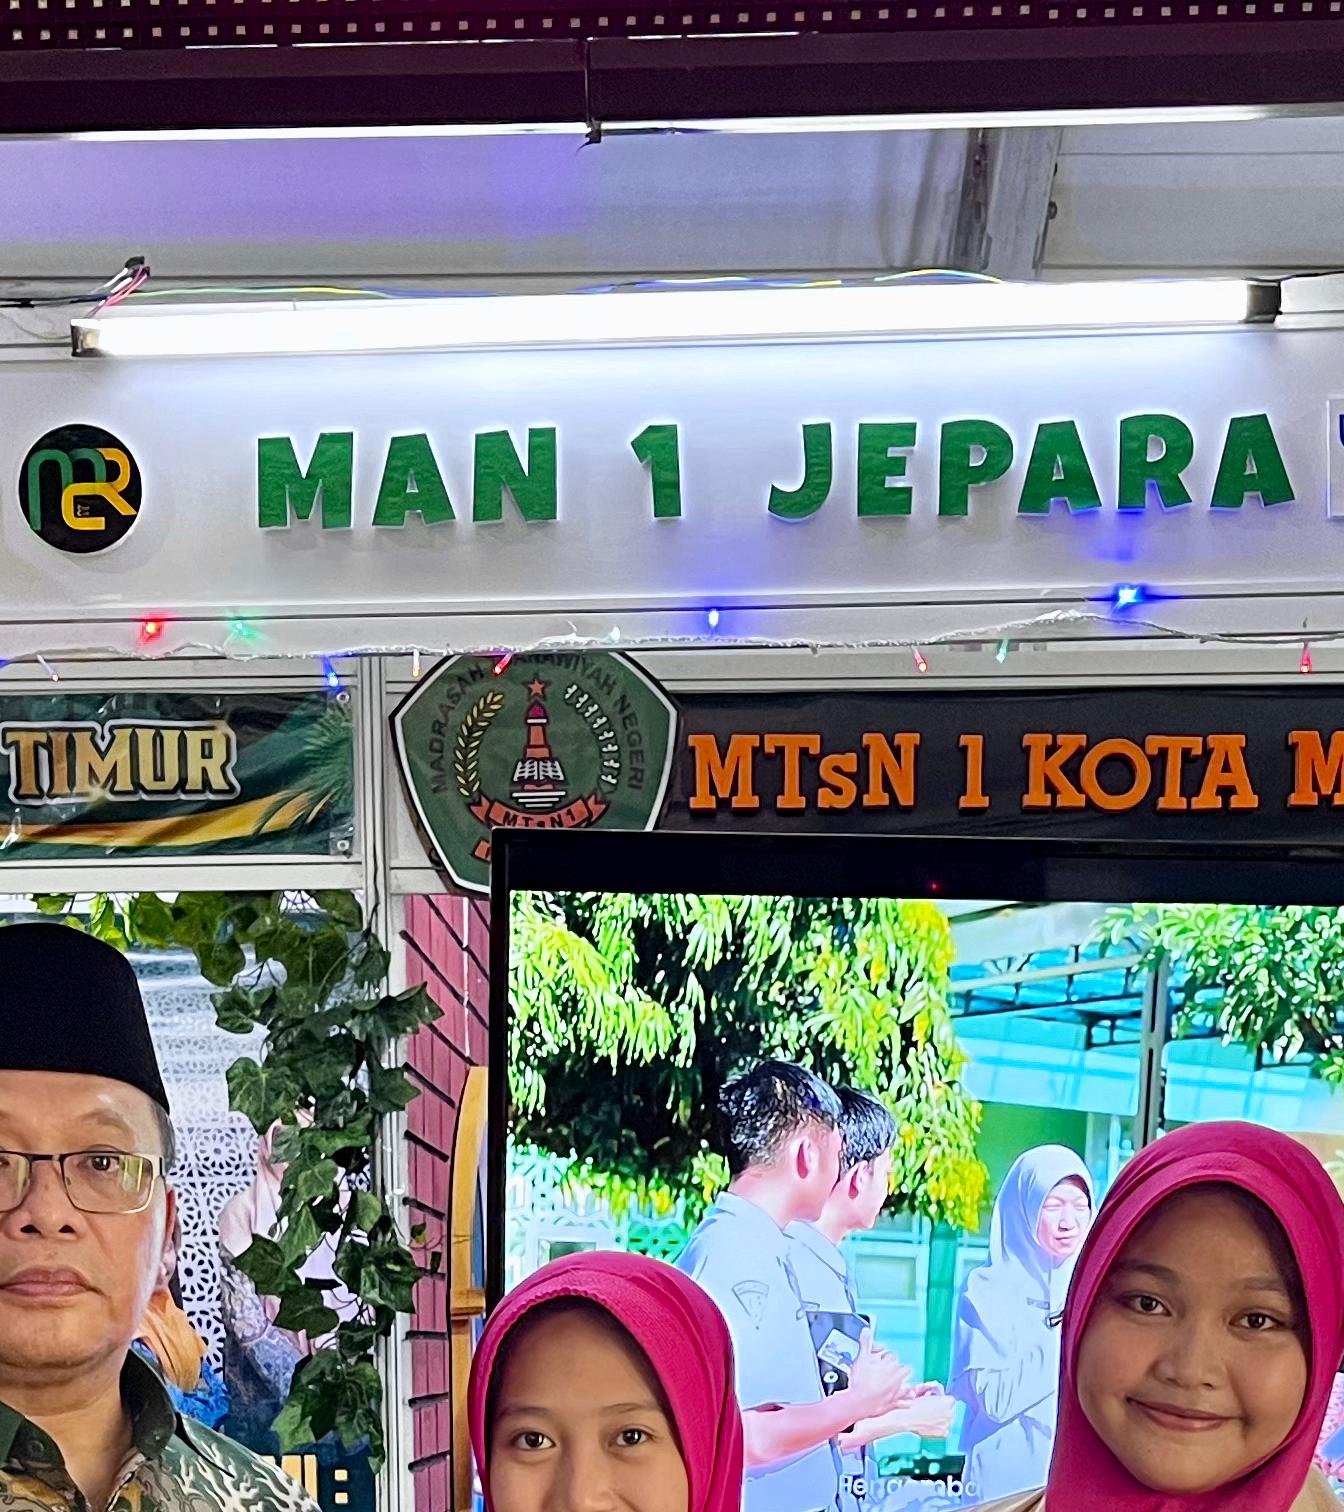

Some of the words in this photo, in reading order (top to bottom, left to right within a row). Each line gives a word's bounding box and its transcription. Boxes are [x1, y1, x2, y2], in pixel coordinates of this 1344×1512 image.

[257, 426, 558, 530] MAN
[630, 424, 682, 519] 1
[768, 413, 1297, 520] JEPARA
[1, 722, 237, 798] TIMUR
[428, 664, 486, 795] MADRASAH
[612, 695, 646, 791] NEGERI
[687, 732, 922, 813] MTsN
[958, 734, 991, 811] 1
[1022, 732, 1259, 812] KOTA
